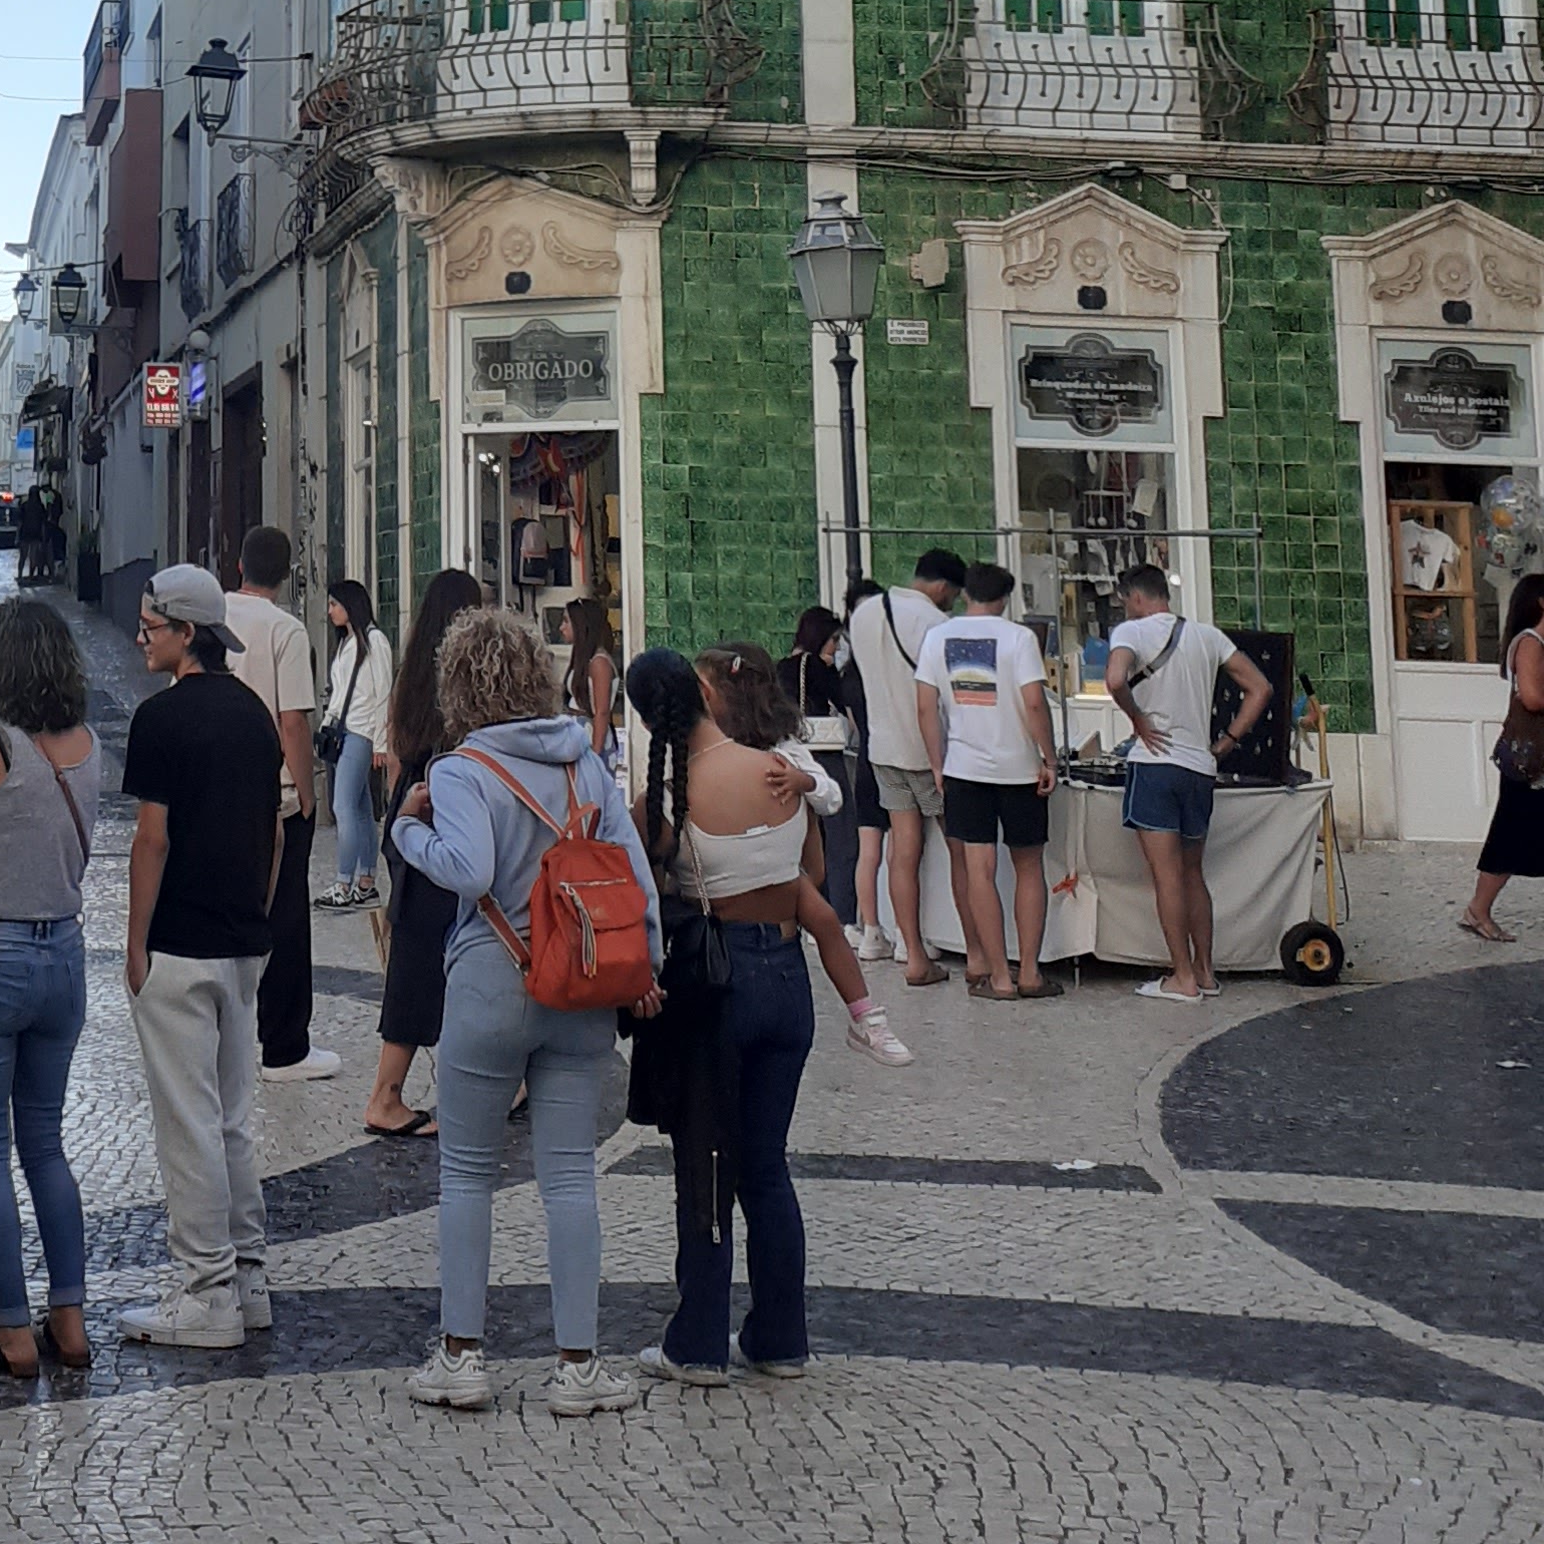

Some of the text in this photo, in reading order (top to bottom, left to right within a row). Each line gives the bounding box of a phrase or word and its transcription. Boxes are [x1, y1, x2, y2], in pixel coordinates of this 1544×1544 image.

[488, 359, 594, 382] OBRIGADO
[1030, 378, 1153, 392] Brinquedos de madeira
[1404, 392, 1511, 407] Azulejos e postais
[1440, 405, 1456, 414] and
